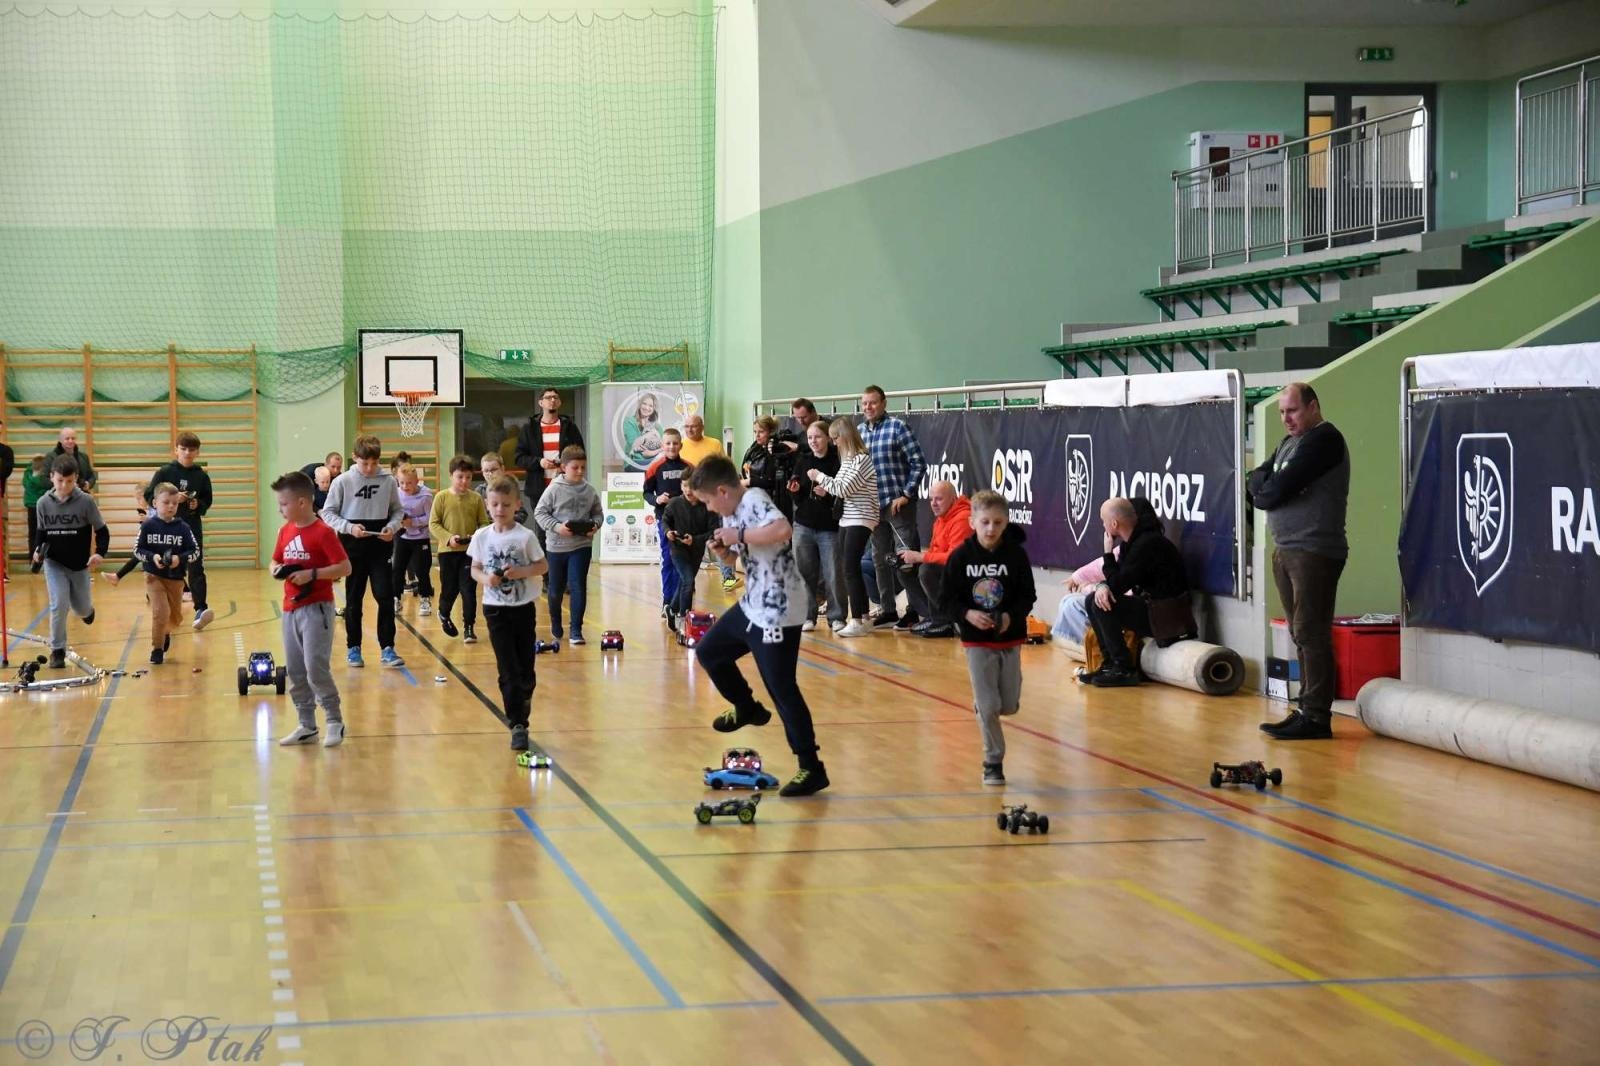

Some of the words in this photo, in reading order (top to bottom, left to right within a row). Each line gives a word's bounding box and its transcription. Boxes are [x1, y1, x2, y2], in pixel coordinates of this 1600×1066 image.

[355, 485, 380, 499] 4F
[44, 514, 79, 525] NASA
[147, 534, 183, 546] BELIEVE
[283, 550, 311, 560] adidas
[966, 564, 1009, 577] NASA
